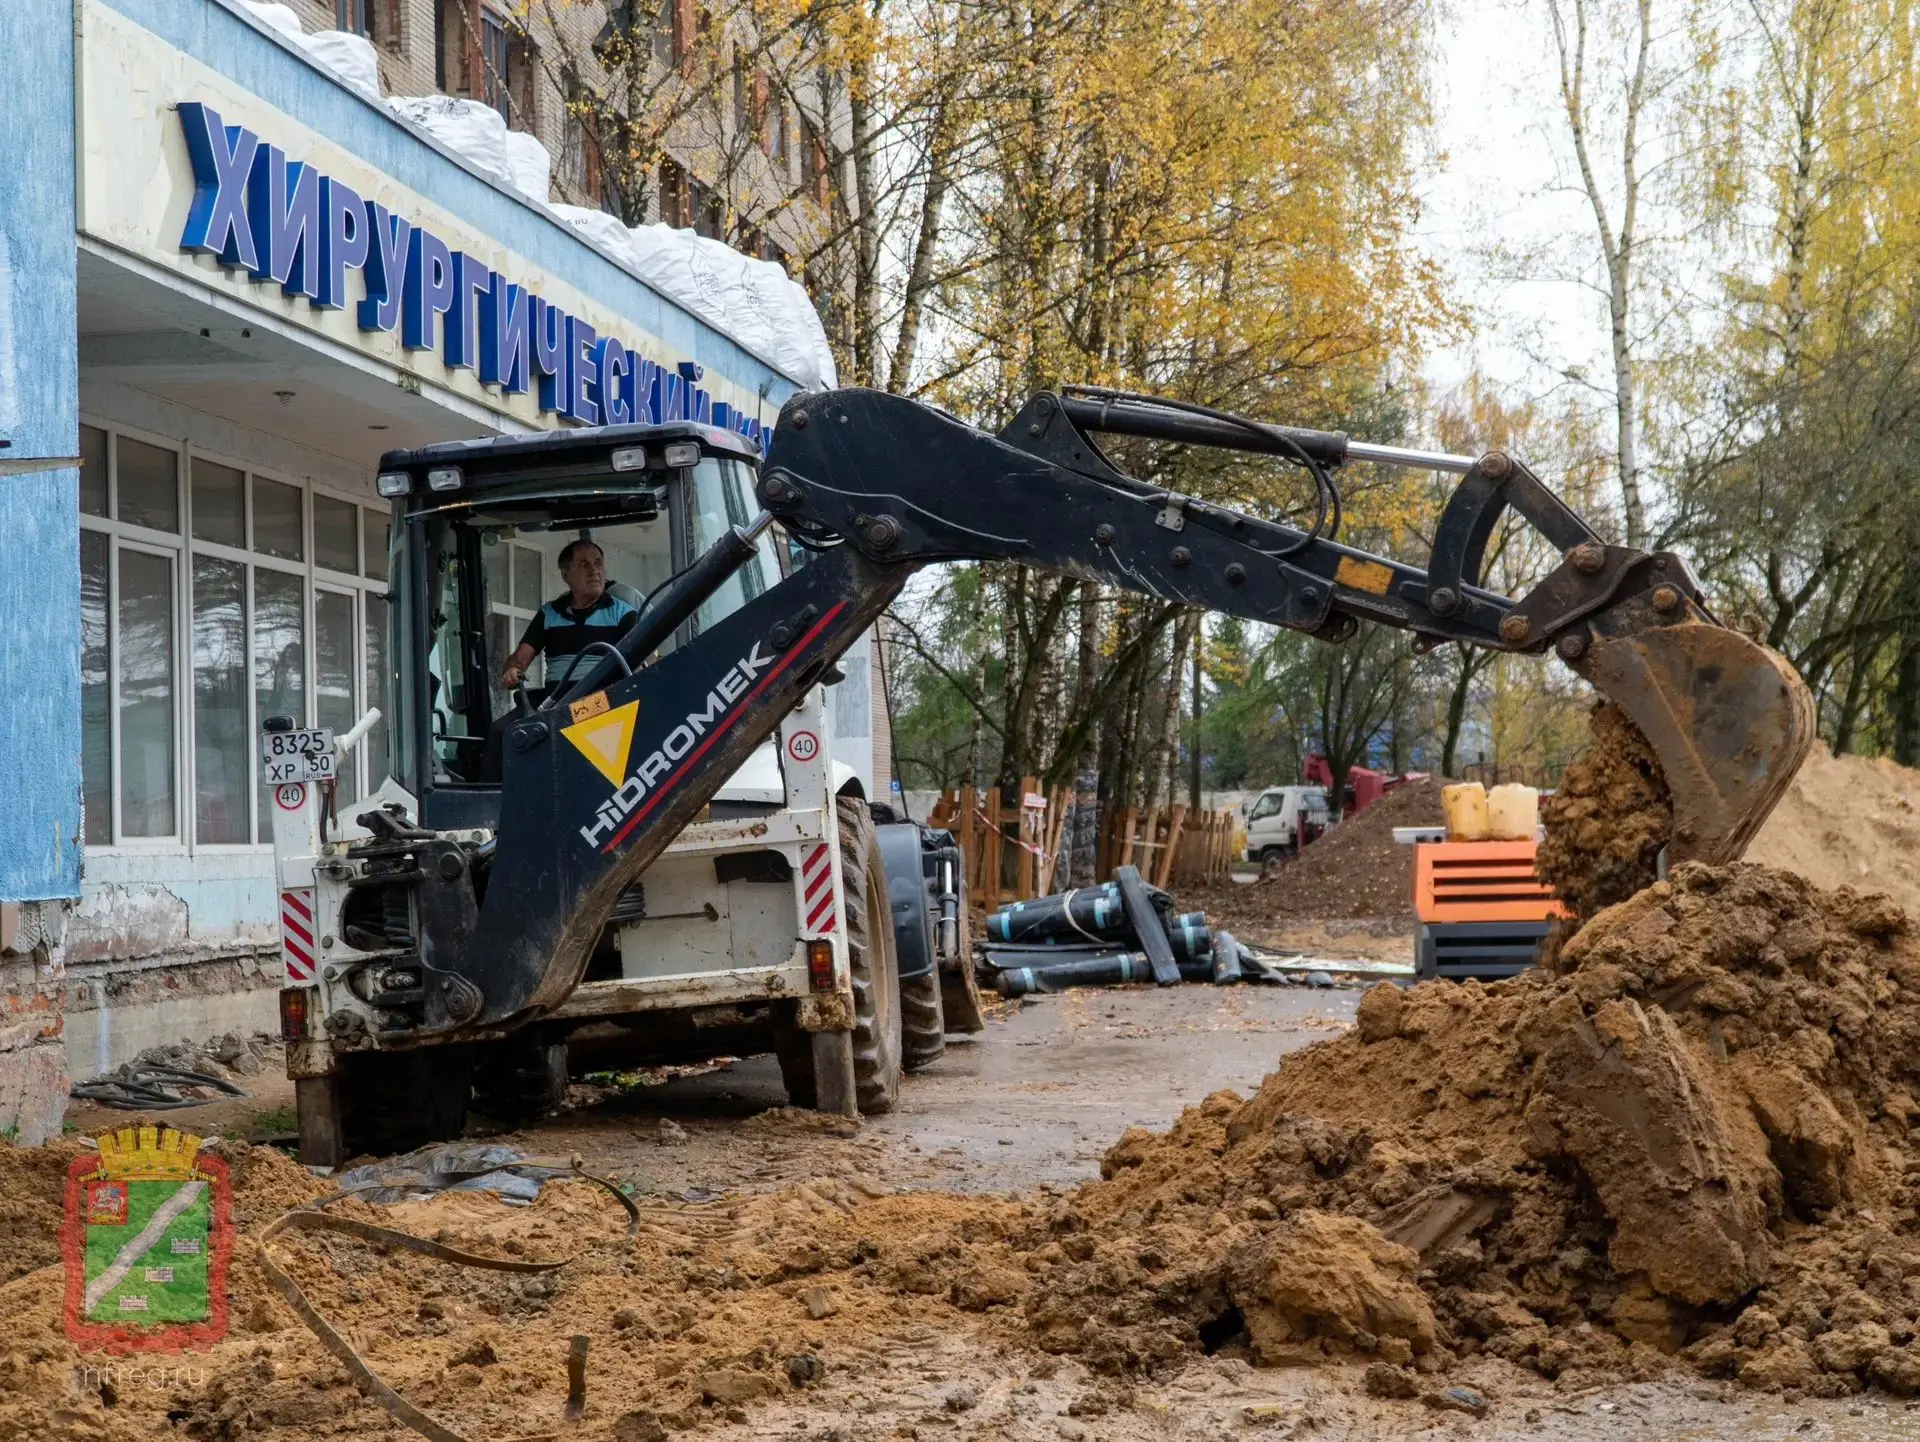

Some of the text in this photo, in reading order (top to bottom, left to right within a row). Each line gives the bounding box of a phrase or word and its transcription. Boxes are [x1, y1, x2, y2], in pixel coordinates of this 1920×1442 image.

[178, 102, 711, 426] ХИРУРГИЧЕСКИЙ
[272, 732, 325, 755] 8325
[794, 739, 813, 753] 40
[310, 756, 330, 771] 50
[281, 788, 300, 802] 40
